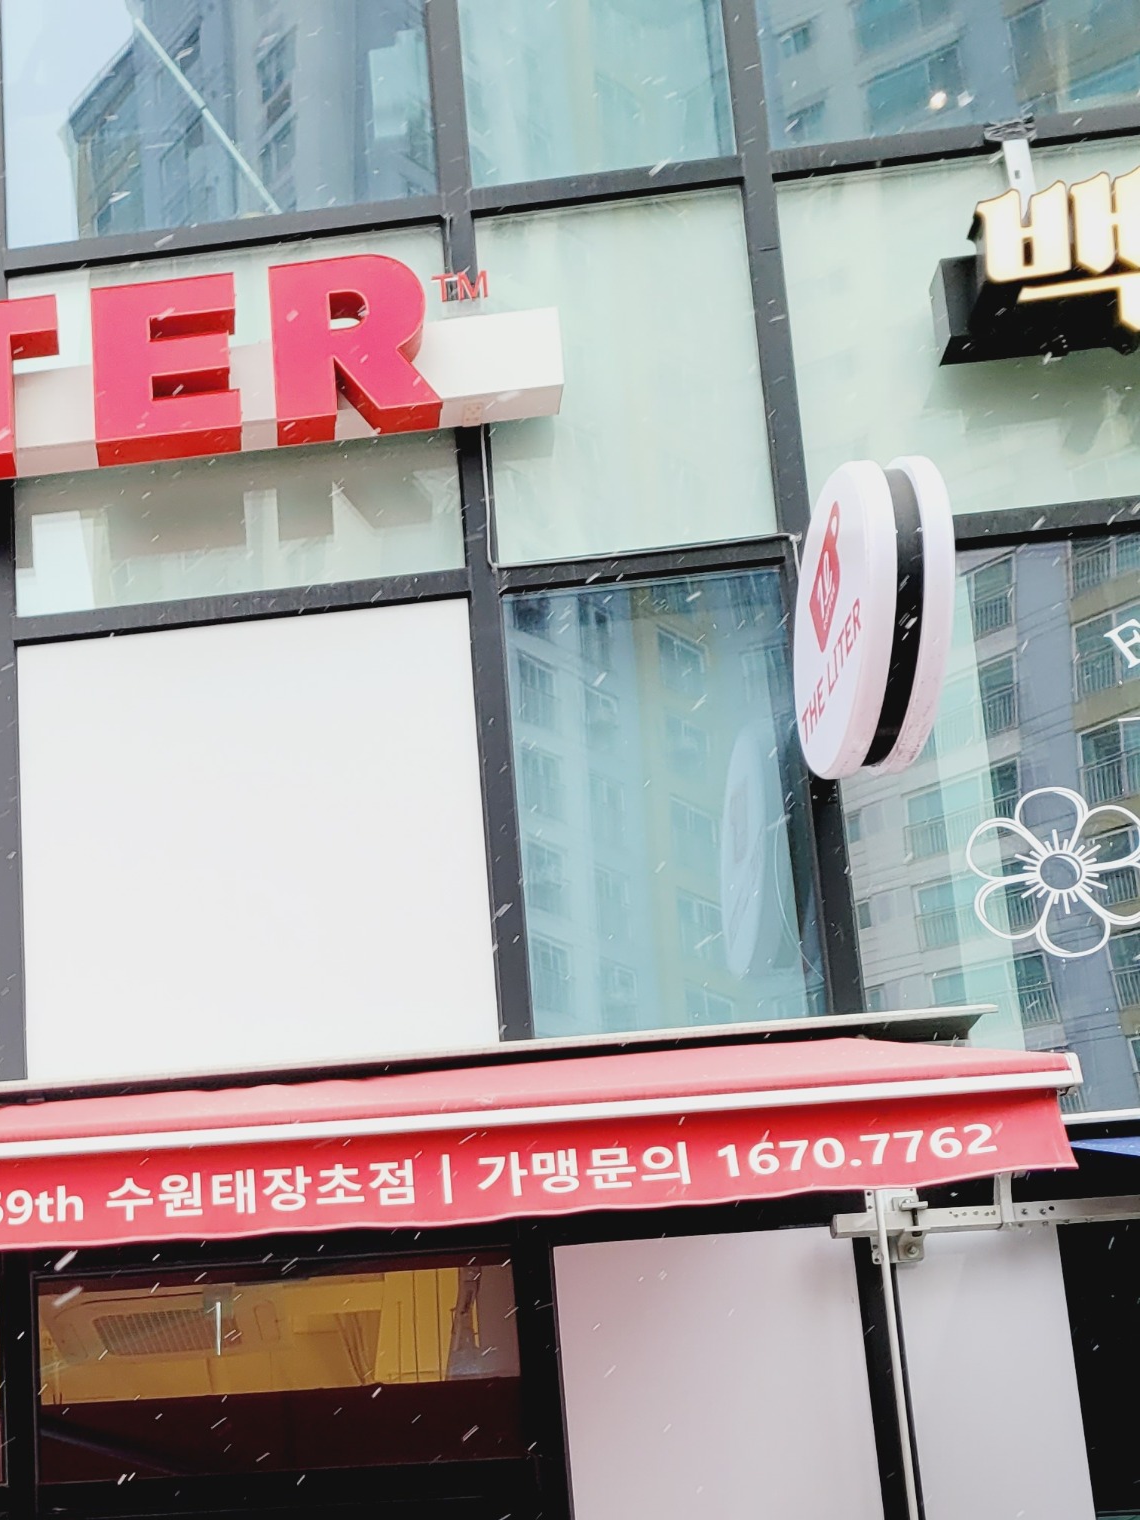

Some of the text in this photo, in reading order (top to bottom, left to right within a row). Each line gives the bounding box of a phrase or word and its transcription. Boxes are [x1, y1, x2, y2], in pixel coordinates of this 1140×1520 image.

[802, 598, 861, 744] THE LITER
[105, 1156, 415, 1223] 수원태장초점
[477, 1140, 690, 1198] 가맹문의
[718, 1122, 998, 1179] 1670.7762
